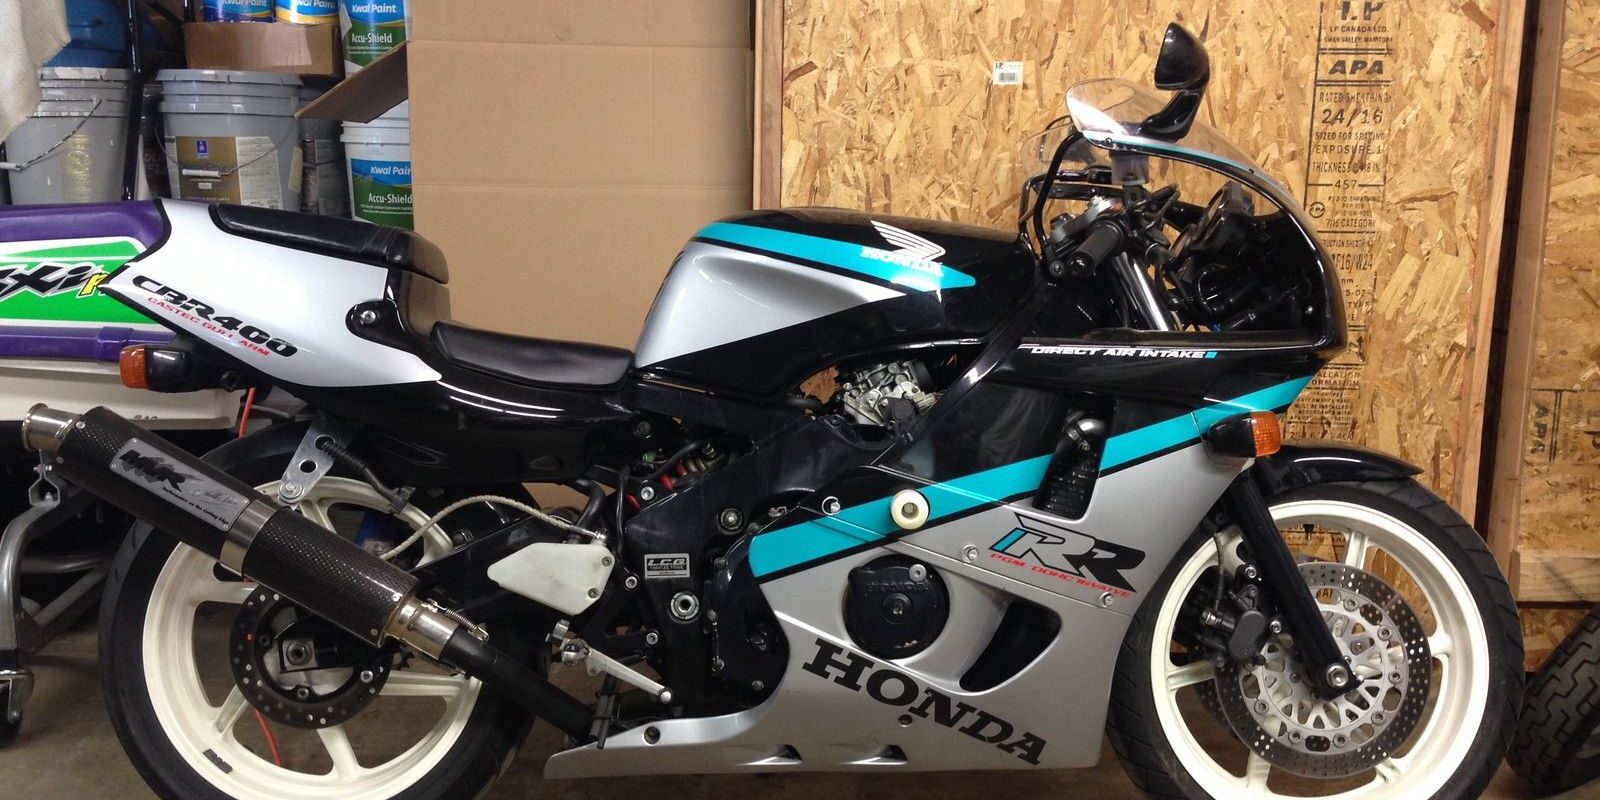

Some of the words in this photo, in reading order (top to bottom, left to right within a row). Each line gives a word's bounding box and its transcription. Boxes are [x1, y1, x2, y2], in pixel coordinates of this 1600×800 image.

[352, 3, 370, 13] Kwal
[372, 3, 397, 13] Paint
[351, 33, 393, 43] Accu-Shield
[1328, 60, 1383, 75] APA
[1321, 108, 1383, 127] 24/16
[1315, 131, 1337, 140] SIZED
[1339, 131, 1353, 140] FOR
[1315, 145, 1372, 155] EXPOSURE
[370, 166, 391, 175] Kwal
[1312, 161, 1351, 173] THICKNESS
[1334, 179, 1357, 190] 457
[1341, 218, 1376, 228] CATEGORY
[1345, 289, 1366, 297] 5-07
[132, 275, 298, 357] CBR400
[148, 297, 199, 323] CASTEC
[238, 338, 270, 356] ARM
[1031, 347, 1101, 355] DIRECT
[1103, 347, 1134, 356] AIR
[1138, 349, 1206, 359] INTAKE
[988, 512, 1146, 592] RR
[990, 553, 1027, 568] PGM
[1031, 565, 1075, 582] DOHC
[802, 637, 1047, 766] HONDA
